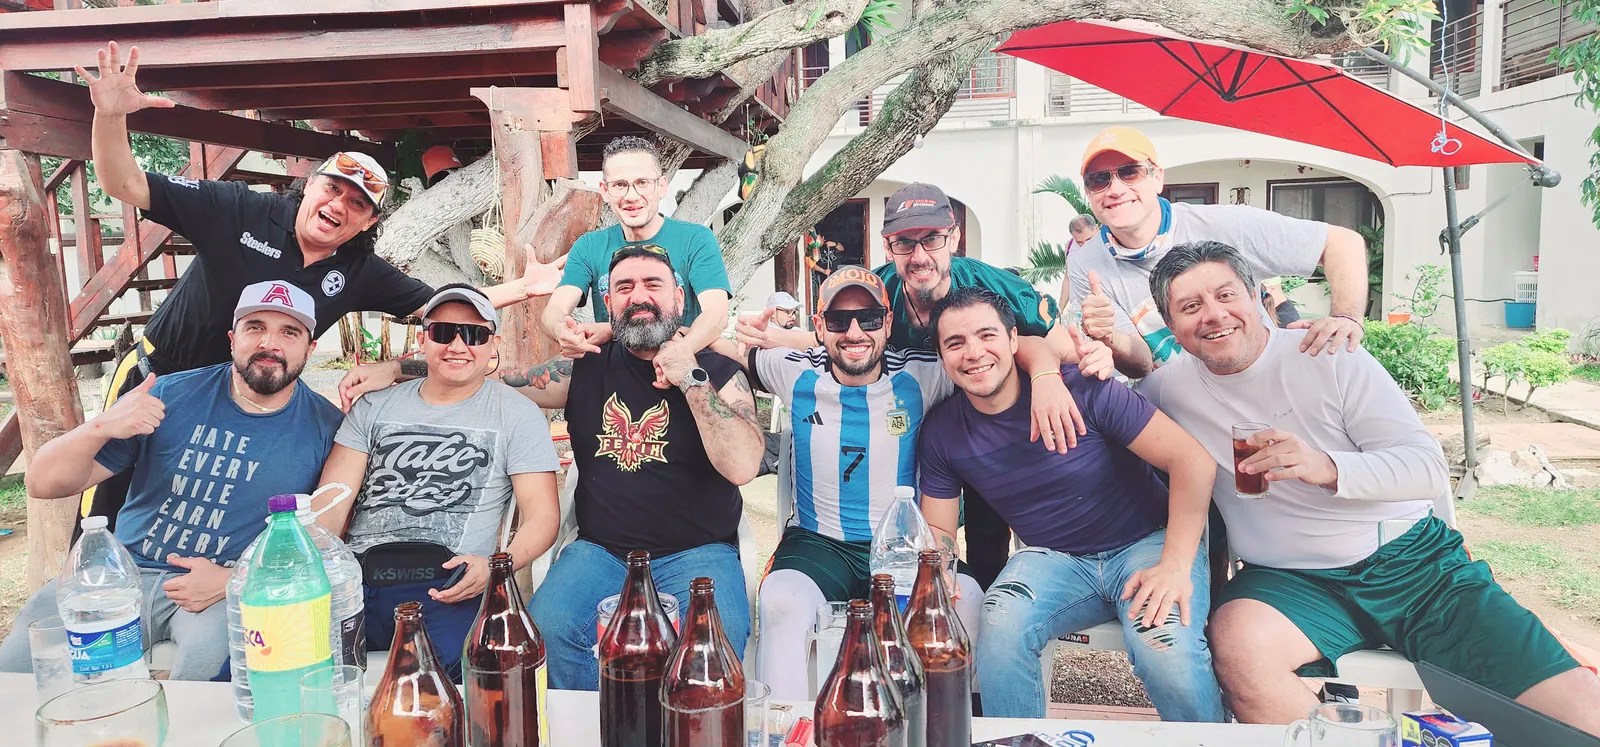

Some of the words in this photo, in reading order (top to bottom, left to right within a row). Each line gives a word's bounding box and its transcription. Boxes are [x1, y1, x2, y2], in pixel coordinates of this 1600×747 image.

[240, 231, 282, 259] Steelers
[260, 283, 293, 307] A
[189, 424, 251, 455] HATE
[379, 433, 487, 474] Take
[178, 448, 259, 481] EVERY
[841, 445, 866, 482] 7
[171, 473, 235, 505] MILE
[159, 496, 225, 530] EARN
[147, 517, 230, 555] EVERY
